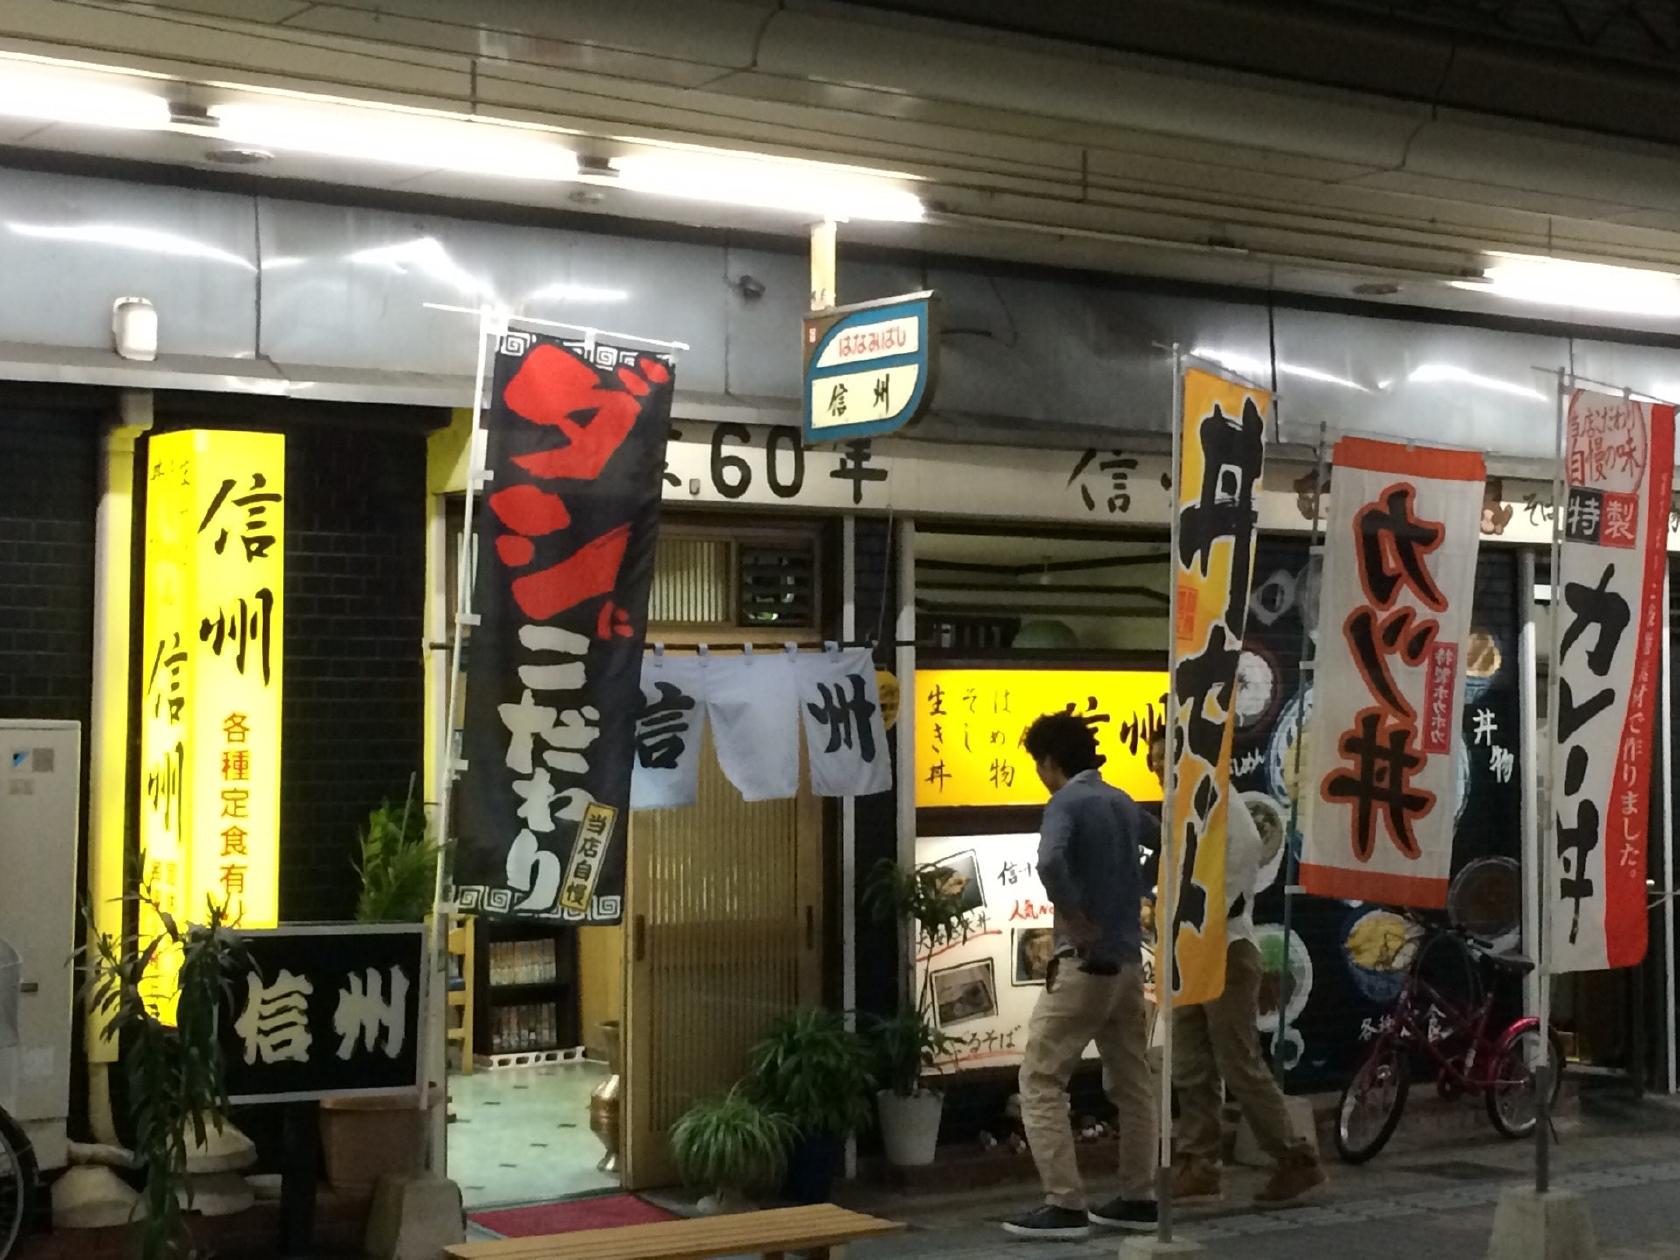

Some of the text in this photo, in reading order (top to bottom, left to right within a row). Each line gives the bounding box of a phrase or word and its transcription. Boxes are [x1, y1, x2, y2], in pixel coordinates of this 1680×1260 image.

[827, 373, 890, 417] 信州
[663, 421, 888, 504] 60年
[1567, 494, 1635, 541] 特製
[198, 473, 283, 687] 信州
[147, 632, 189, 846] 信州
[1473, 708, 1515, 784] 丼物
[219, 711, 250, 928] 各種定食有
[566, 814, 608, 906] 当店自慢
[234, 964, 411, 1066] 信州
